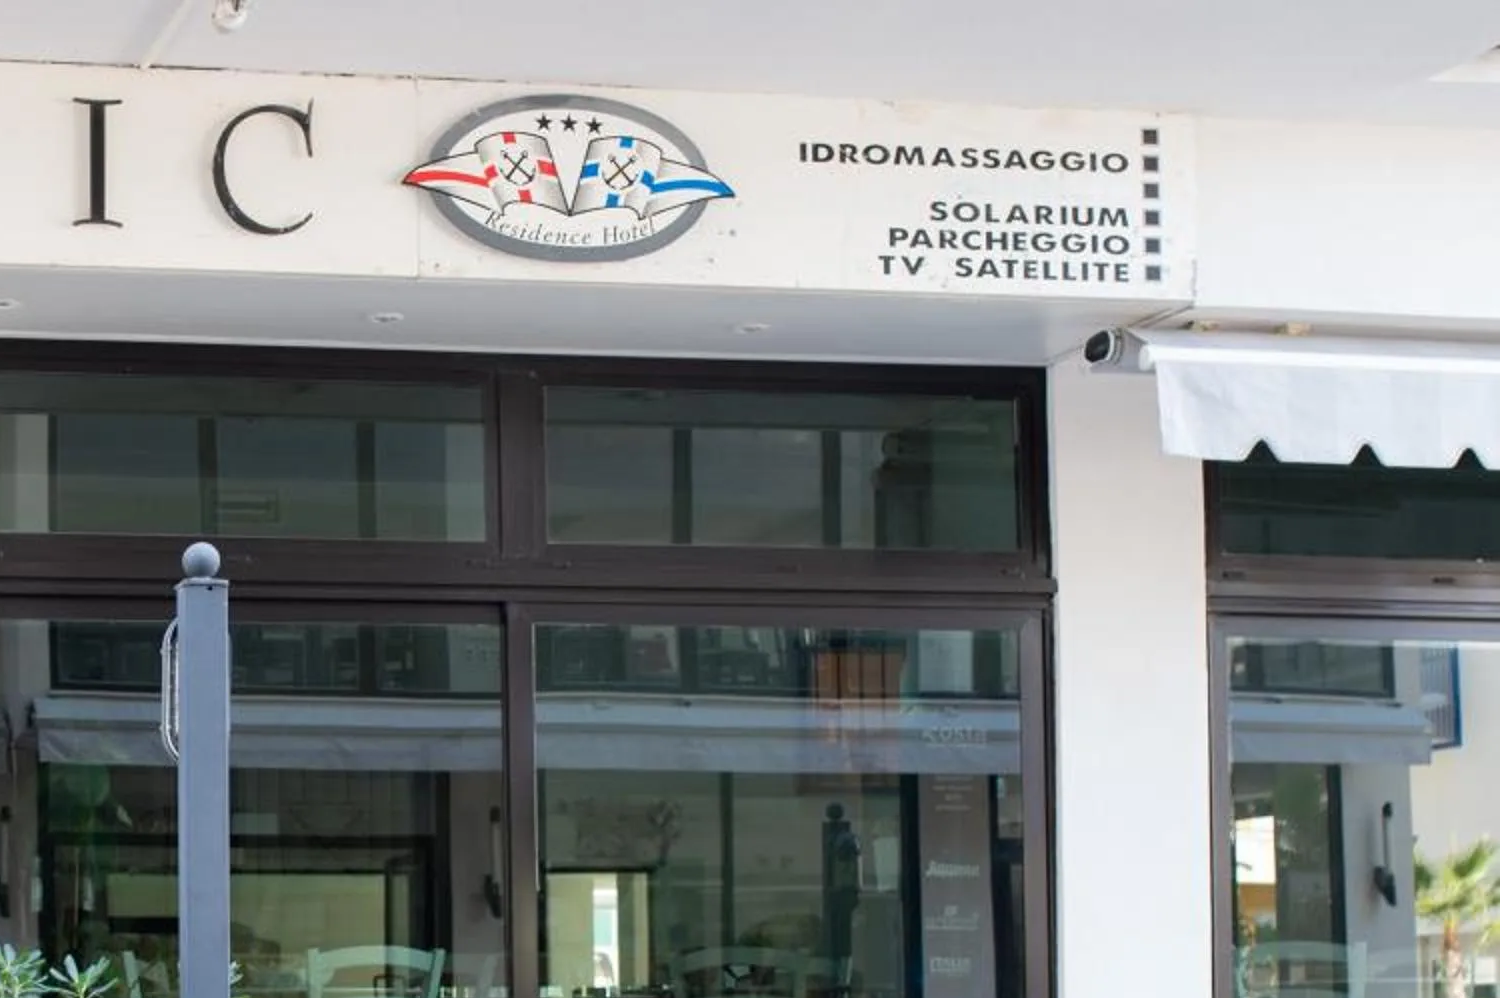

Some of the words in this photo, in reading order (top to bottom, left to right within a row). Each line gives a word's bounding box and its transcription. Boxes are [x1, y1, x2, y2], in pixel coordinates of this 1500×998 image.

[799, 142, 1129, 173] IDROMASSAGGIO
[484, 210, 592, 245] Residence
[603, 213, 656, 244] Hotel
[929, 201, 1130, 228] SOLARIUM
[888, 227, 1131, 256] PARCHEGGIO
[878, 255, 925, 276] TV
[954, 257, 1130, 283] SATELLITE
